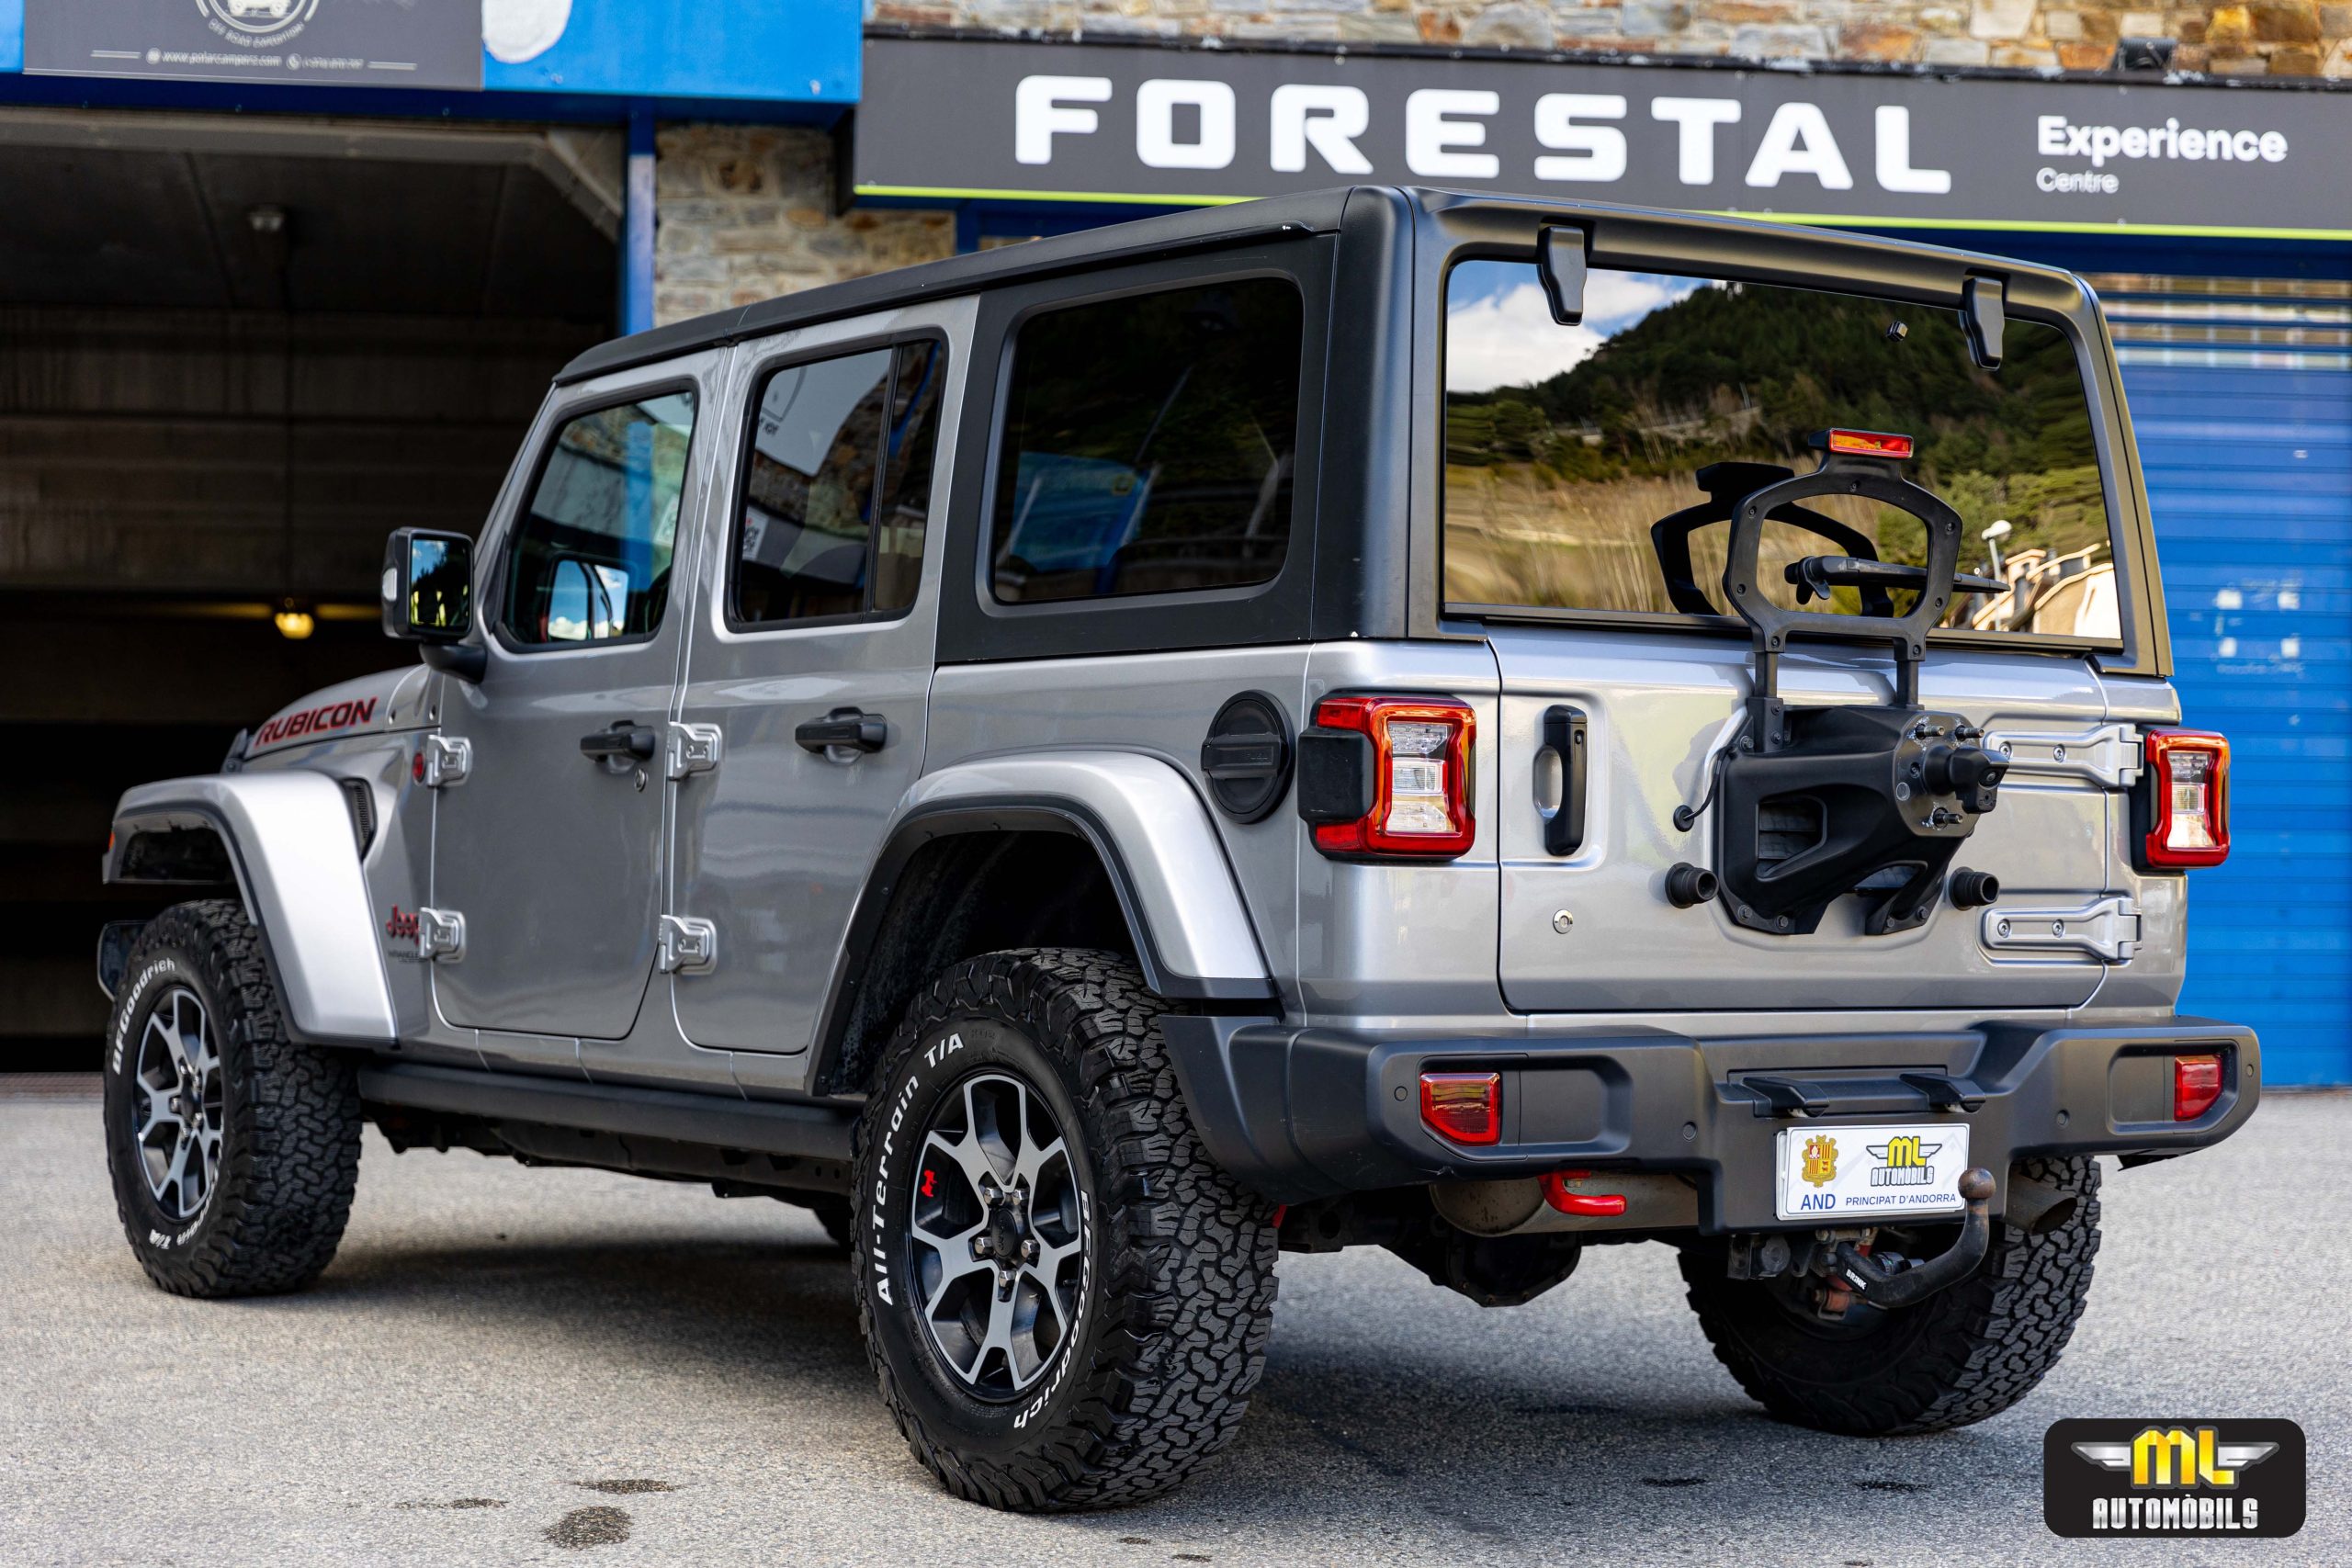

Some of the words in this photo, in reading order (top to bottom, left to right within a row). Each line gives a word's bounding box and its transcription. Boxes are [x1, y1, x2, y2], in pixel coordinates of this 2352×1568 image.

[1015, 75, 1951, 194] FORESTAL
[2038, 115, 2289, 167] Experience
[2036, 167, 2120, 194] Centre
[254, 697, 378, 747] RUBICON
[112, 956, 176, 1076] BFGoodrich
[872, 1075, 919, 1306] All-Terrain
[924, 1032, 965, 1068] T/A
[1888, 1135, 1928, 1168] ML
[1801, 1194, 1836, 1210] AND
[1846, 1195, 1896, 1206] PRINCIPAT
[1899, 1193, 1956, 1204] D'ANDORRA
[1013, 1190, 1092, 1429] BFGoodrich
